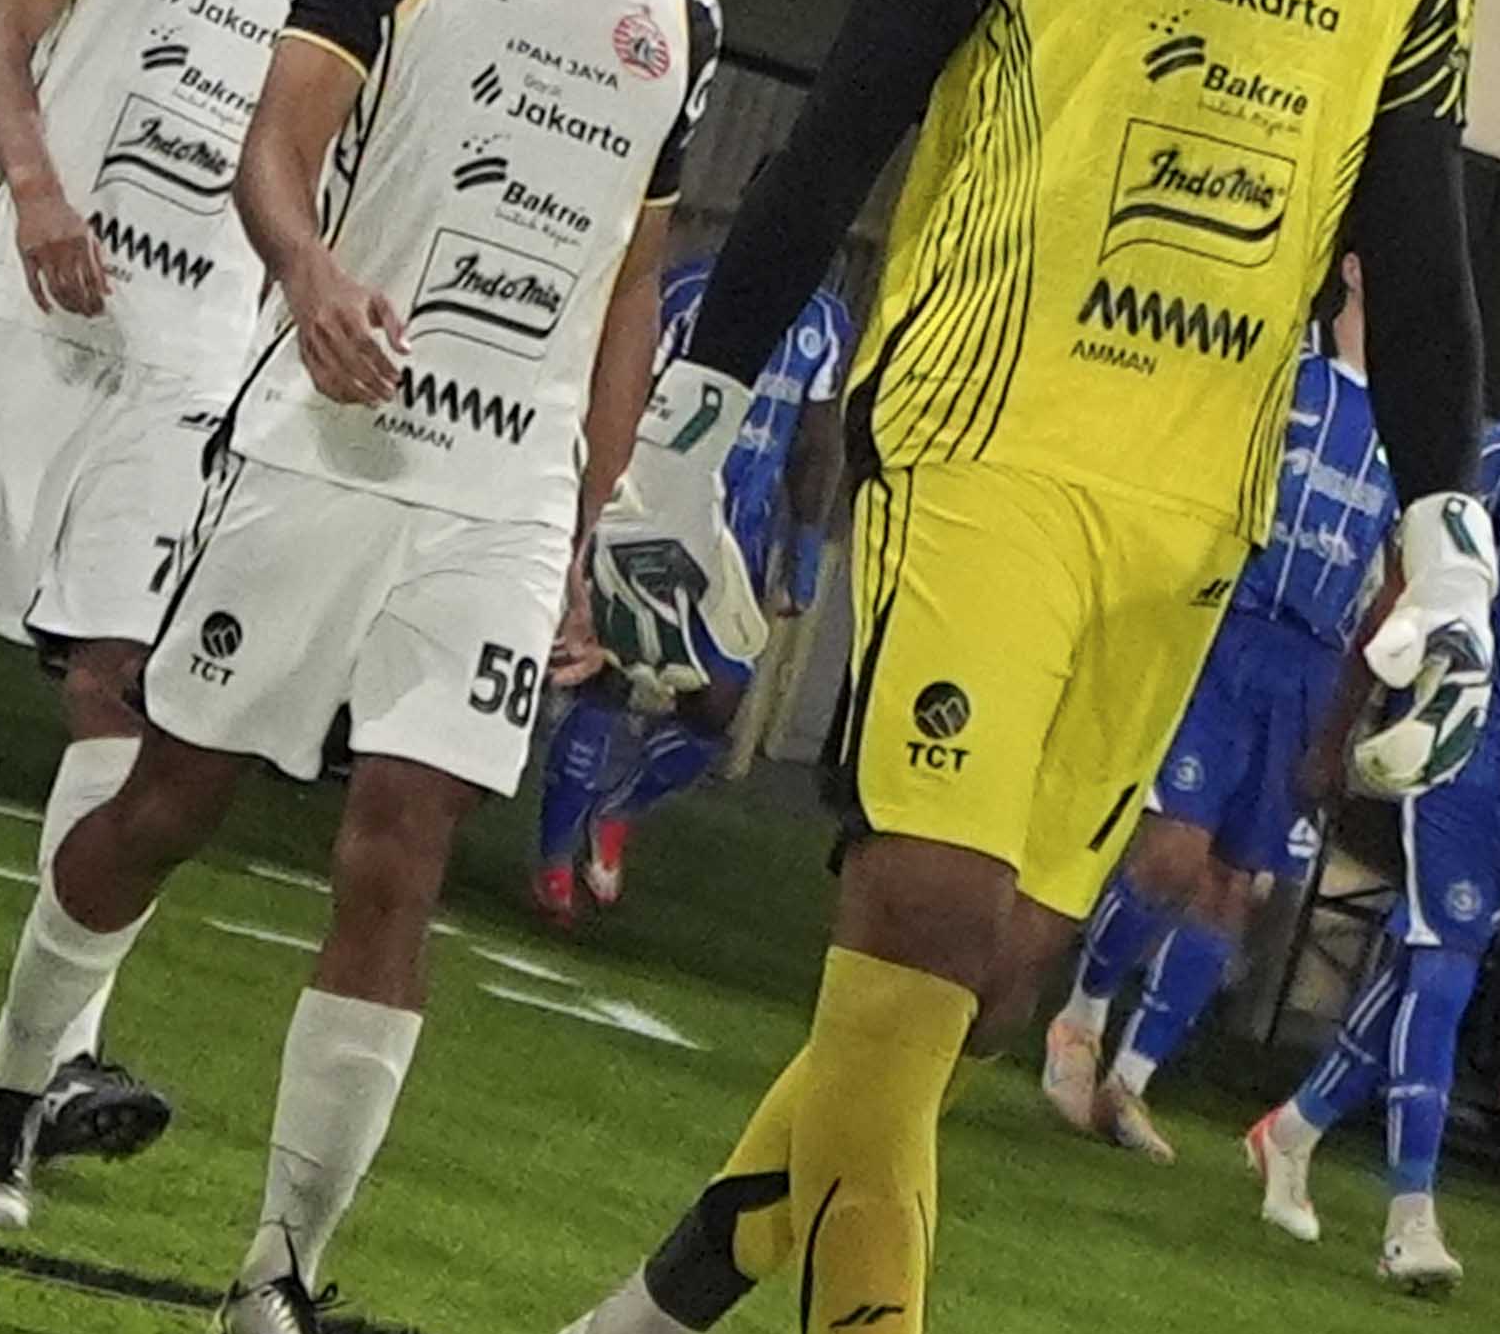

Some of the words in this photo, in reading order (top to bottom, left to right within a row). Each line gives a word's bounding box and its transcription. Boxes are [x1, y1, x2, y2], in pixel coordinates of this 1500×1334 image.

[517, 39, 562, 72] PAM
[566, 60, 619, 92] JAYA
[1202, 63, 1309, 117] Bakrie
[507, 94, 632, 159] Jakarta
[502, 180, 592, 233] Bakrie
[1070, 338, 1157, 376] AMMAN
[189, 654, 235, 687] TCT
[467, 641, 539, 729] 58
[906, 740, 971, 773] TCT
